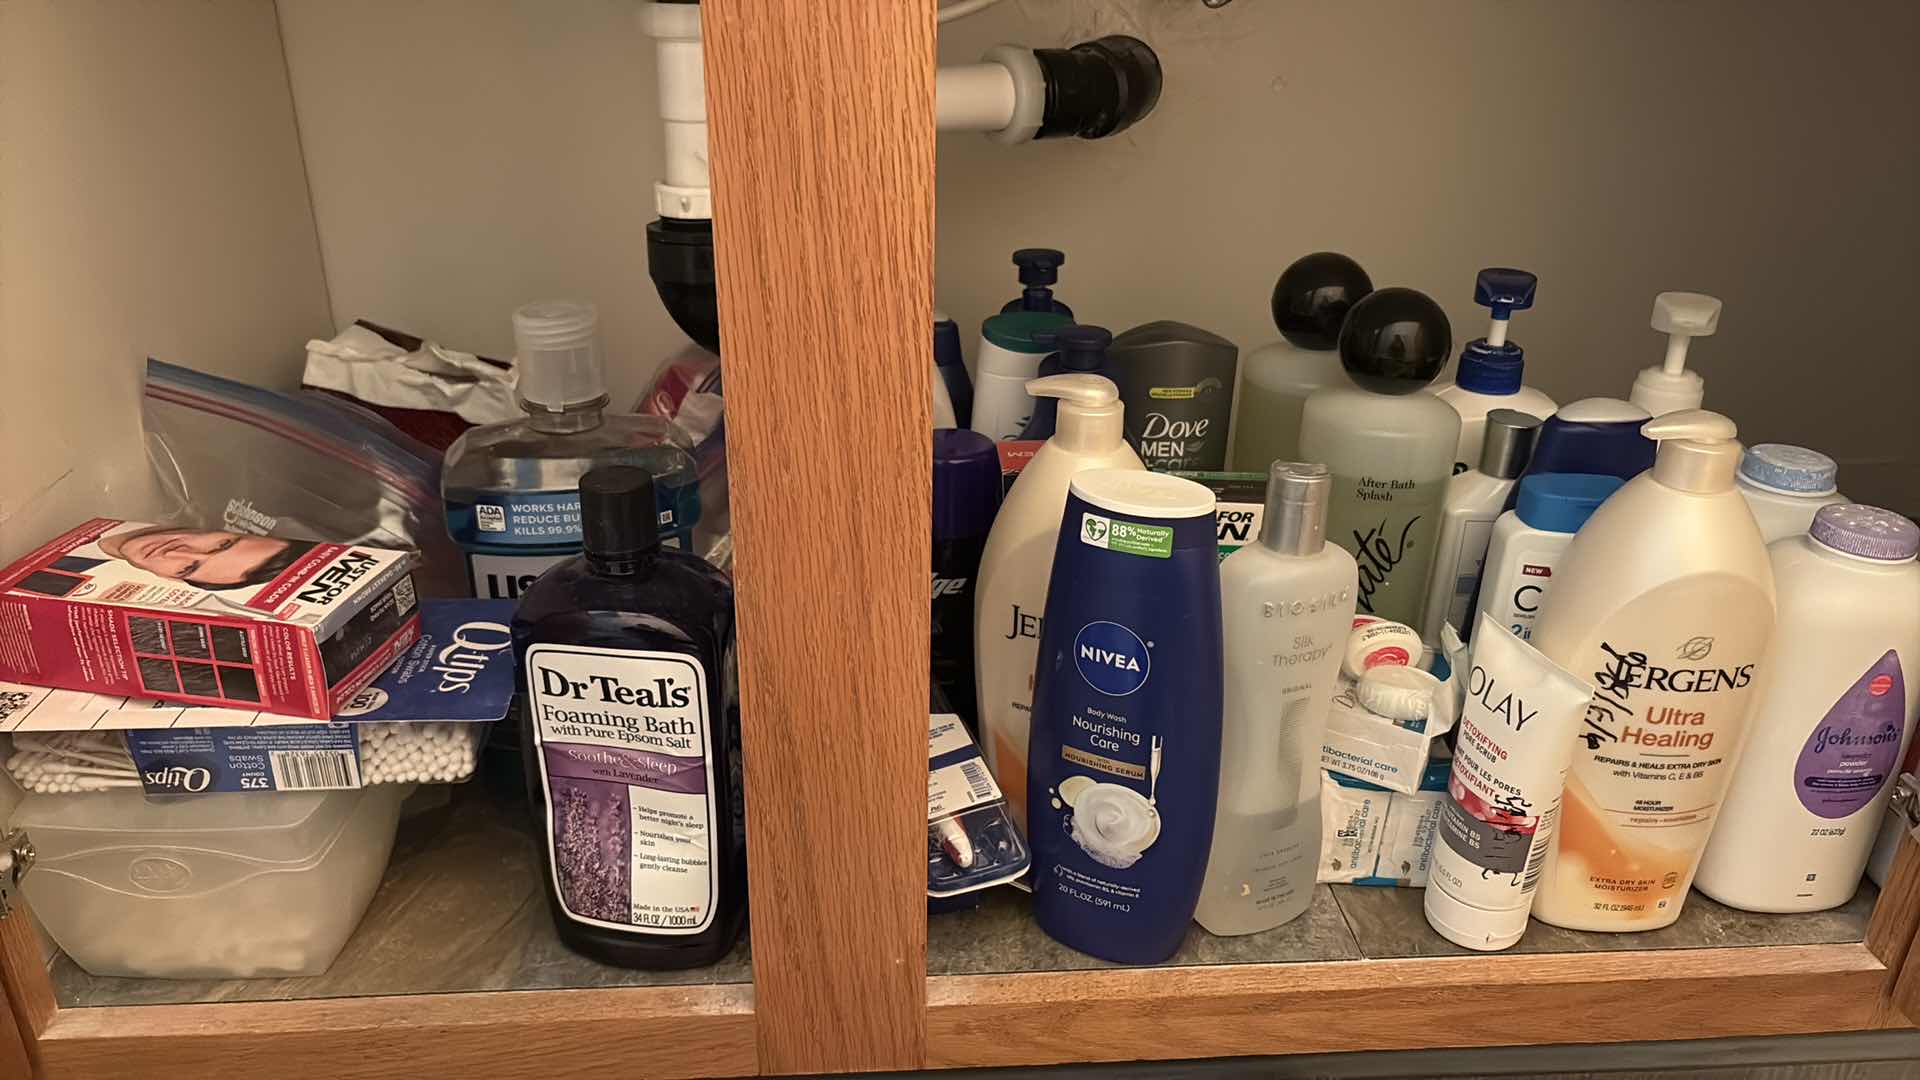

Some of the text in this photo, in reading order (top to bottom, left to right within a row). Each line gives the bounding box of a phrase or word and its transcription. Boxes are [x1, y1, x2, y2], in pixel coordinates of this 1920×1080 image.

[1142, 412, 1209, 439] Dove
[1141, 441, 1184, 457] MEN
[1358, 476, 1415, 490] After Bath
[1356, 488, 1393, 502] Splash
[480, 506, 501, 515] ADA
[512, 503, 554, 512] WORKS
[513, 515, 560, 524] REDUCE
[1218, 511, 1254, 523] FOR
[514, 526, 545, 535] KILLS
[1112, 524, 1169, 538] 88% Naturally
[1136, 535, 1163, 543] Derived
[296, 551, 374, 603] MEN
[317, 558, 379, 605] JUST FOR
[264, 581, 292, 604] COLOR
[1514, 584, 1543, 612] C
[412, 634, 433, 659] Cotton
[1293, 635, 1314, 650] Silk
[1081, 643, 1141, 673] NIVEA
[1272, 646, 1329, 667] Therapy
[398, 658, 420, 684] Swabs
[1612, 653, 1754, 692] JERGENS
[538, 666, 690, 708] Dr Teal's
[349, 693, 373, 710] 100
[1469, 666, 1538, 731] OLAY
[542, 704, 696, 735] Foaming Bath
[1087, 707, 1127, 724] Body Wash
[1646, 706, 1706, 726] Ultra
[550, 725, 692, 749] with Pure Epsom Salt
[1073, 715, 1141, 746] Nourishing
[1621, 726, 1714, 751] Healing
[1090, 734, 1120, 752] Care
[1476, 743, 1497, 763] SCRUB
[568, 750, 621, 764] Soothe
[638, 757, 678, 775] Sleep
[1374, 762, 1398, 774] care
[1594, 755, 1631, 767] REPAIRS
[1639, 762, 1665, 770] HEALS
[1667, 762, 1691, 770] EXTRA
[1692, 761, 1707, 769] DRY
[240, 777, 269, 789] 375
[612, 769, 659, 784] Lavender
[1464, 755, 1521, 796] POUR LES PORES
[1613, 770, 1631, 778] with
[1632, 771, 1666, 780] Vitamins
[1679, 772, 1685, 780] E
[639, 814, 659, 823] better
[685, 822, 704, 830] sleep
[640, 830, 674, 841] Nourishes
[640, 863, 661, 871] gently
[1590, 876, 1616, 884] EXTRA
[1594, 883, 1649, 892] MOISTURIZER
[1056, 882, 1068, 893] 20
[1094, 897, 1111, 909] (591
[1113, 903, 1130, 913] mL)
[633, 913, 641, 923] 34
[669, 916, 687, 926] 1000
